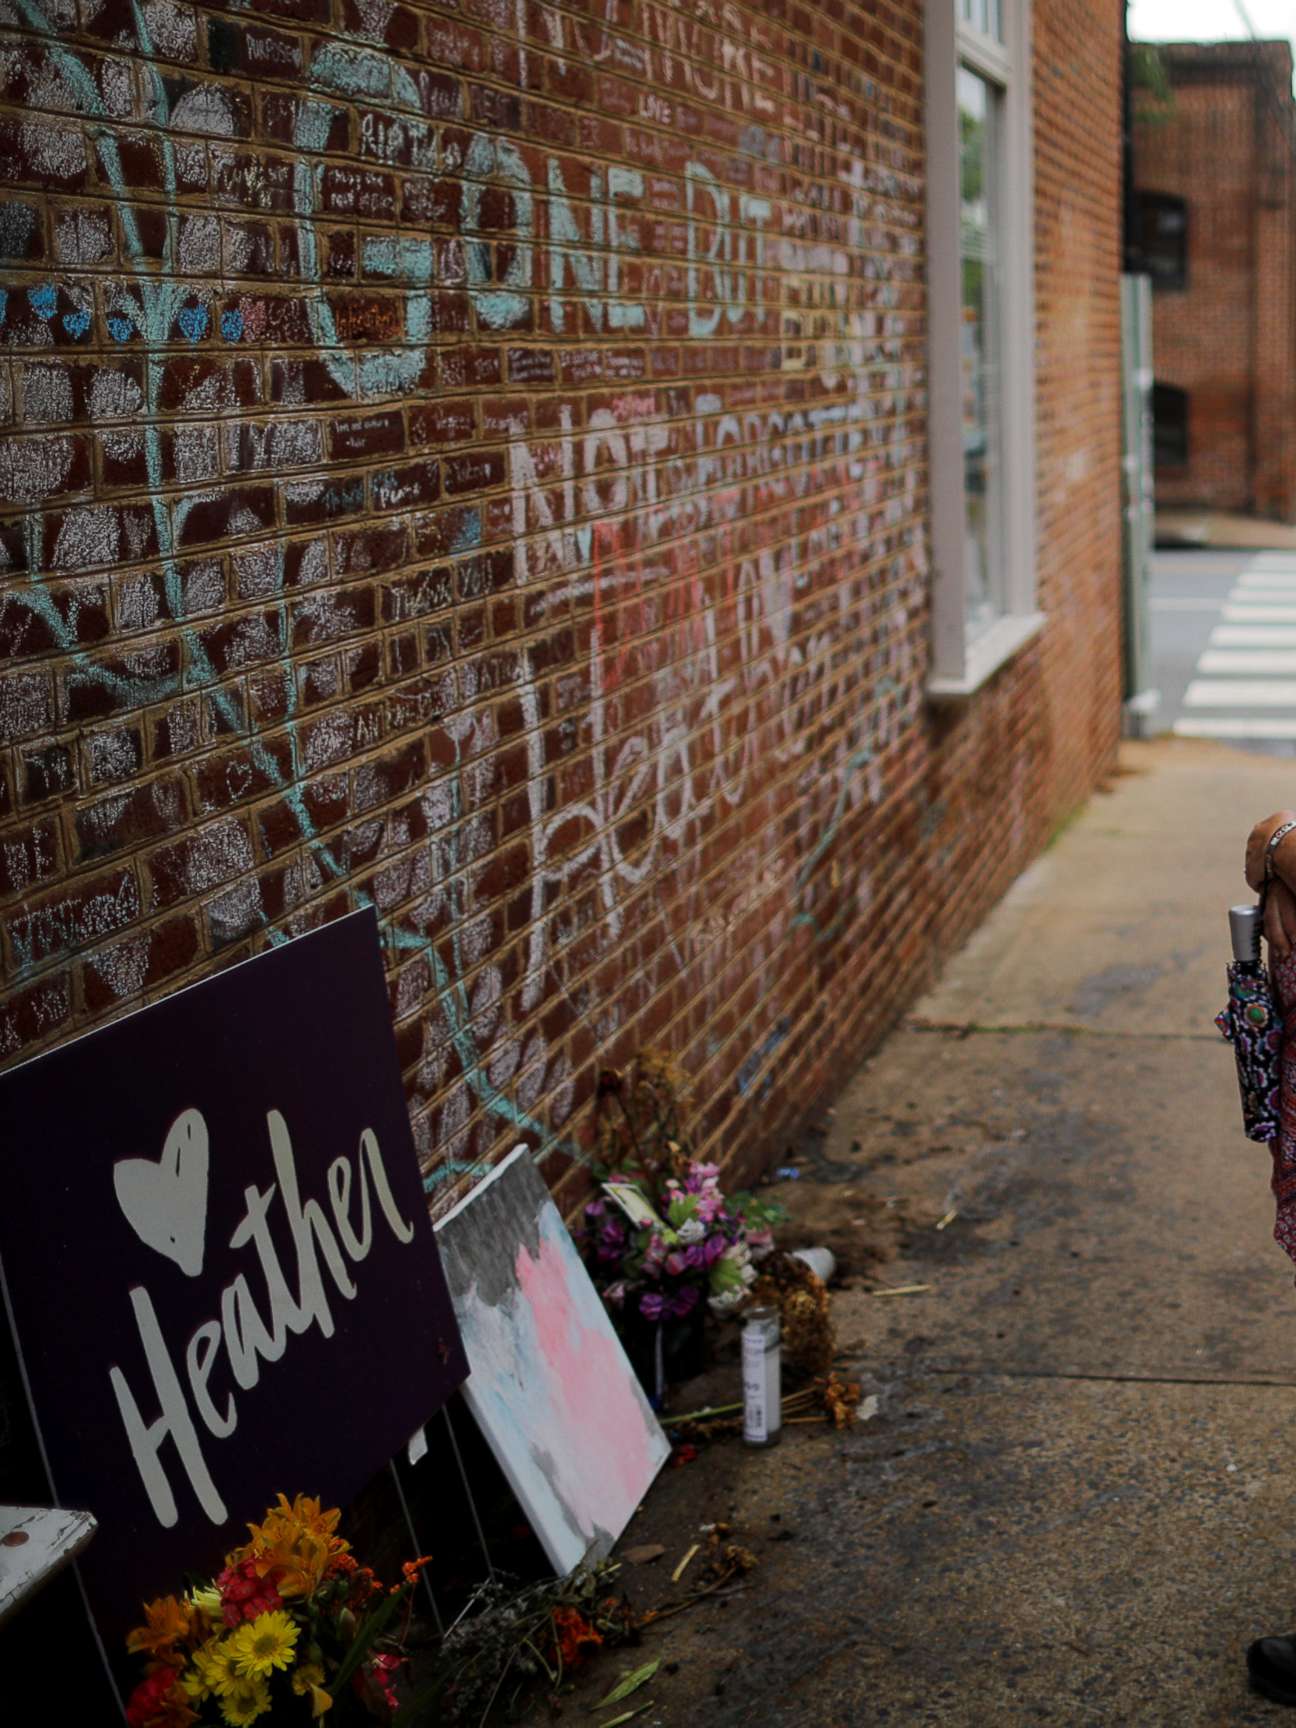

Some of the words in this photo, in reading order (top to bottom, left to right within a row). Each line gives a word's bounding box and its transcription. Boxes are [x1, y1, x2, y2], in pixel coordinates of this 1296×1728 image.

[293, 42, 645, 397] GONE
[685, 161, 771, 338] BUT
[508, 404, 669, 589] NOT
[110, 1110, 415, 1528] Heather
